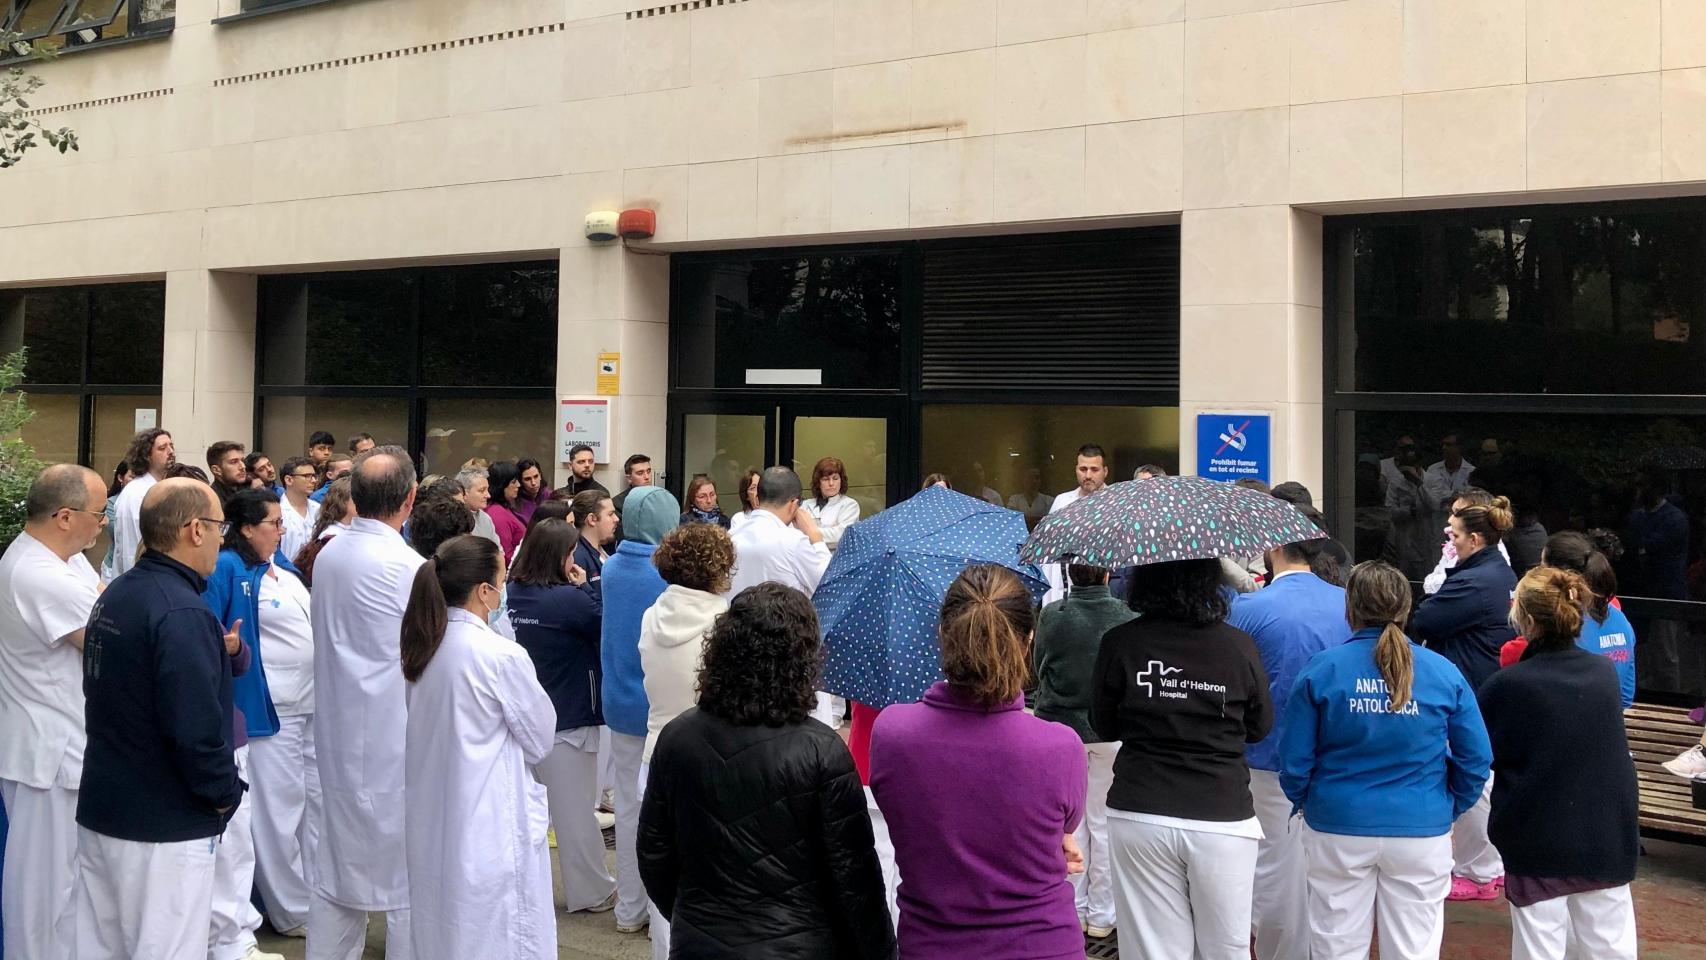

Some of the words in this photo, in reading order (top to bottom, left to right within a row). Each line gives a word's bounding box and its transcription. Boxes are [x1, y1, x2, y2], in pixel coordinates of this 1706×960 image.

[1237, 459, 1257, 467] fumar
[1160, 678, 1178, 688] Vall
[1180, 679, 1226, 693] d'Hebron
[1159, 690, 1188, 699] Hospital
[1349, 695, 1419, 716] PATOLÒICA
